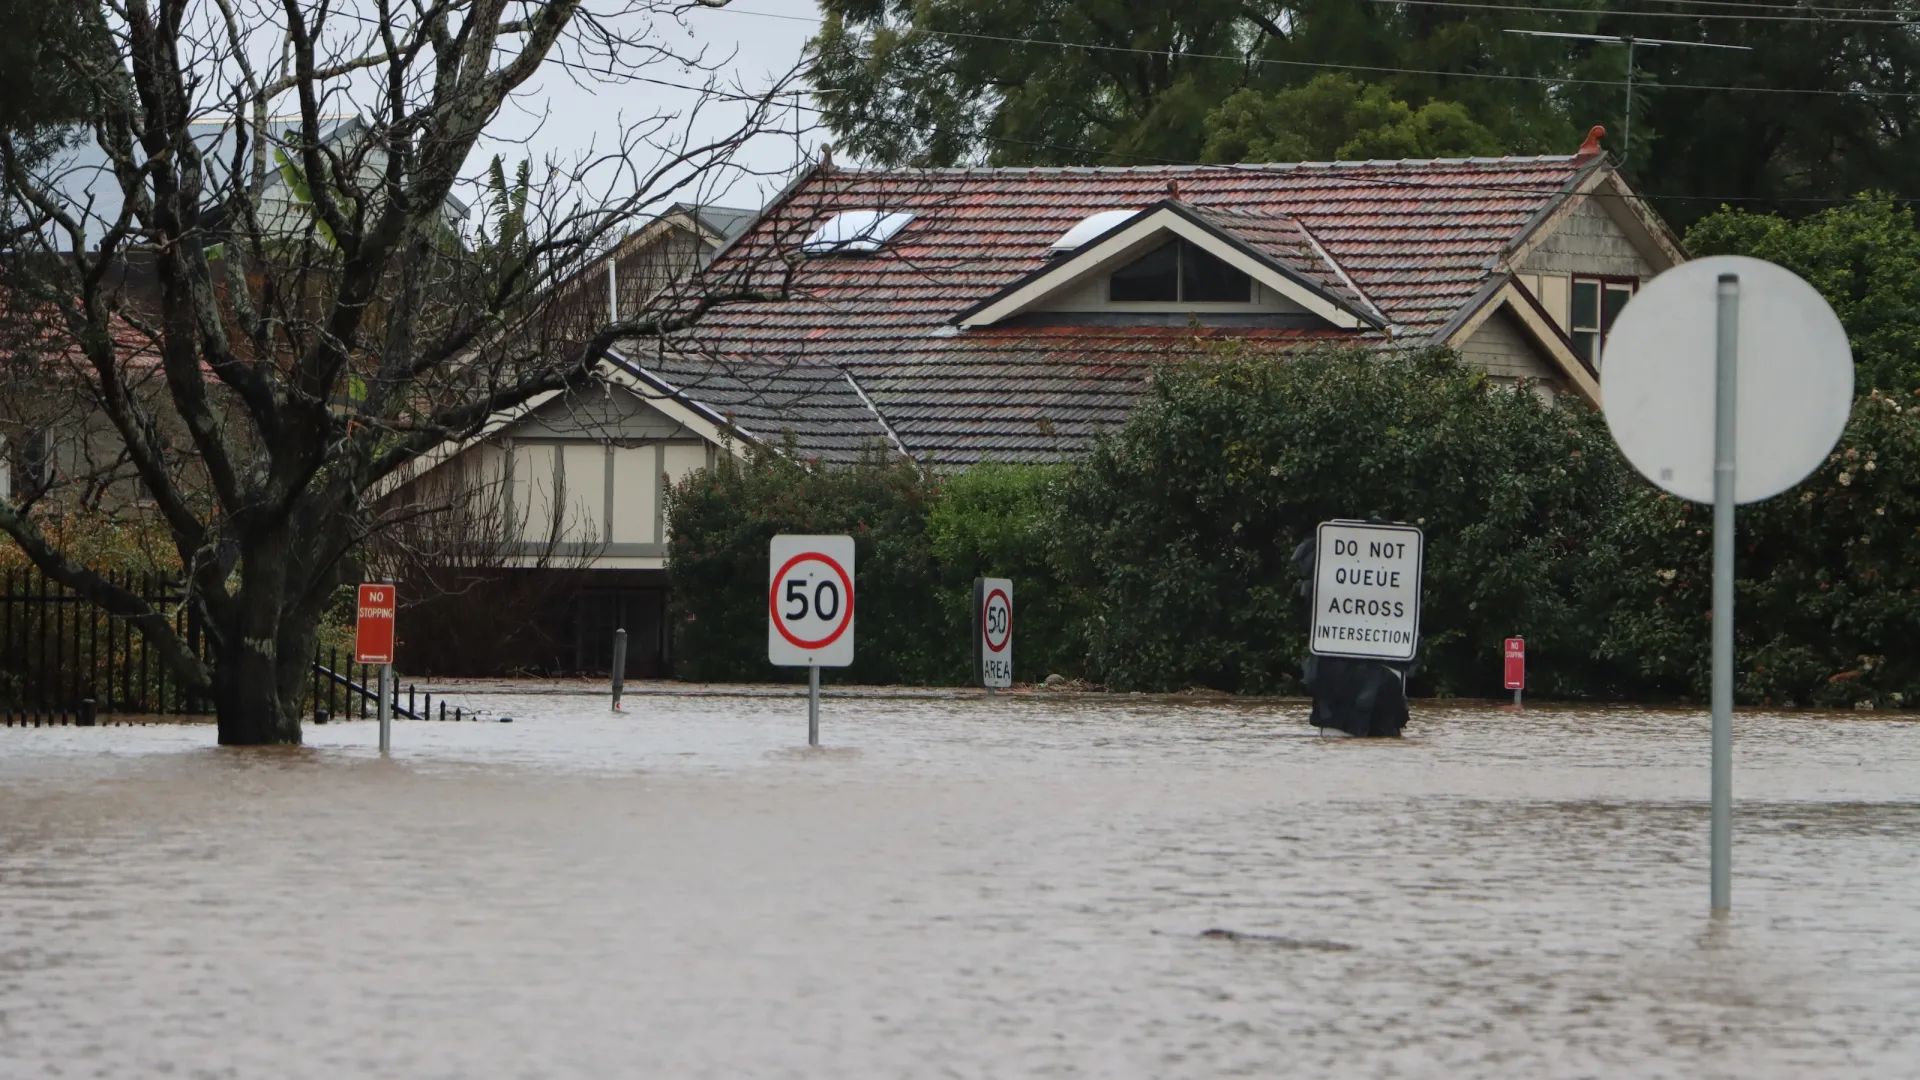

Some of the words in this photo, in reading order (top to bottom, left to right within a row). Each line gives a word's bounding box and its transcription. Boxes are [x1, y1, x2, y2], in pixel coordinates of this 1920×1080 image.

[1335, 539, 1358, 556] DO
[1370, 541, 1405, 559] NOT
[1335, 568, 1400, 588] QUEUE
[369, 591, 384, 602] NO
[785, 579, 839, 621] 50
[360, 607, 393, 618] STOPPING
[1328, 597, 1404, 617] ACROSS
[988, 606, 1006, 634] 50
[1318, 625, 1411, 644] INTERSECTION
[1511, 641, 1519, 650] NO
[984, 660, 1011, 679] AREA
